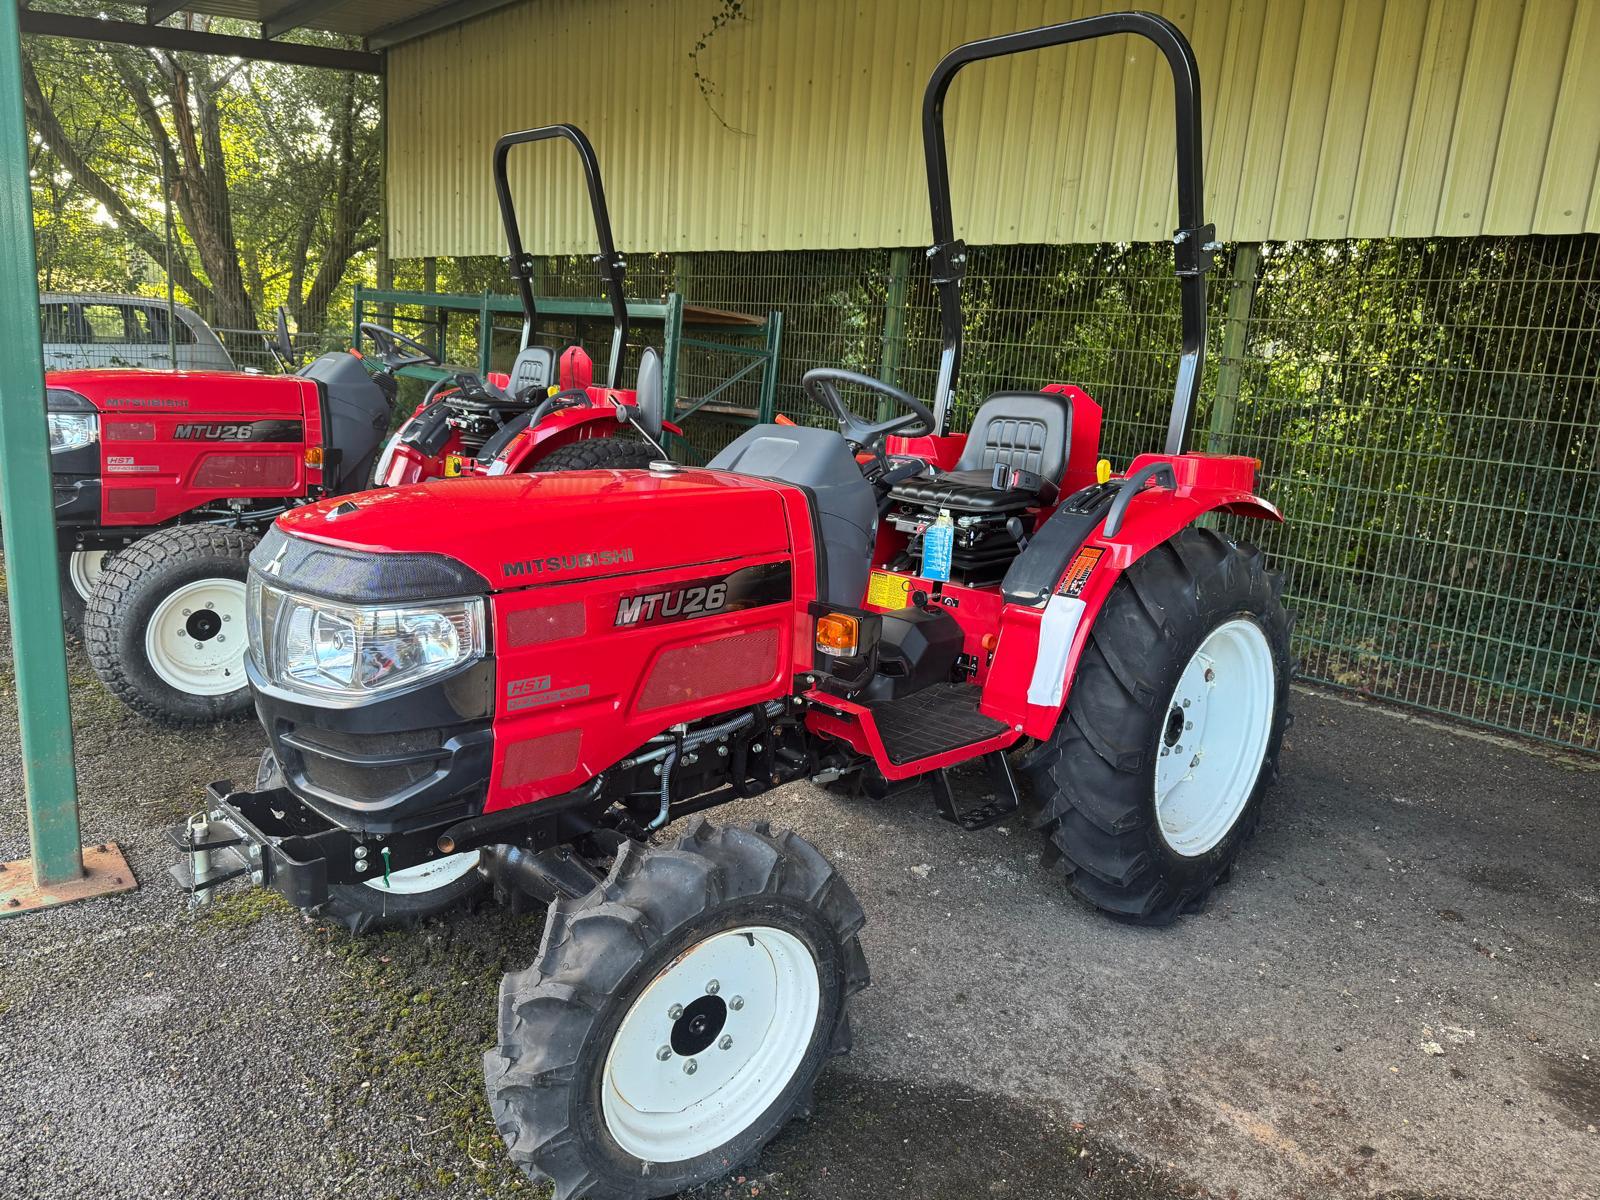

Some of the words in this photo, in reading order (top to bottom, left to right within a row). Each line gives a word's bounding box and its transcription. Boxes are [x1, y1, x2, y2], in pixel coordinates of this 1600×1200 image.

[173, 423, 253, 442] MTU26
[503, 548, 634, 577] MITSUBISHI
[613, 582, 728, 627] MTU26
[511, 677, 548, 694] HST
